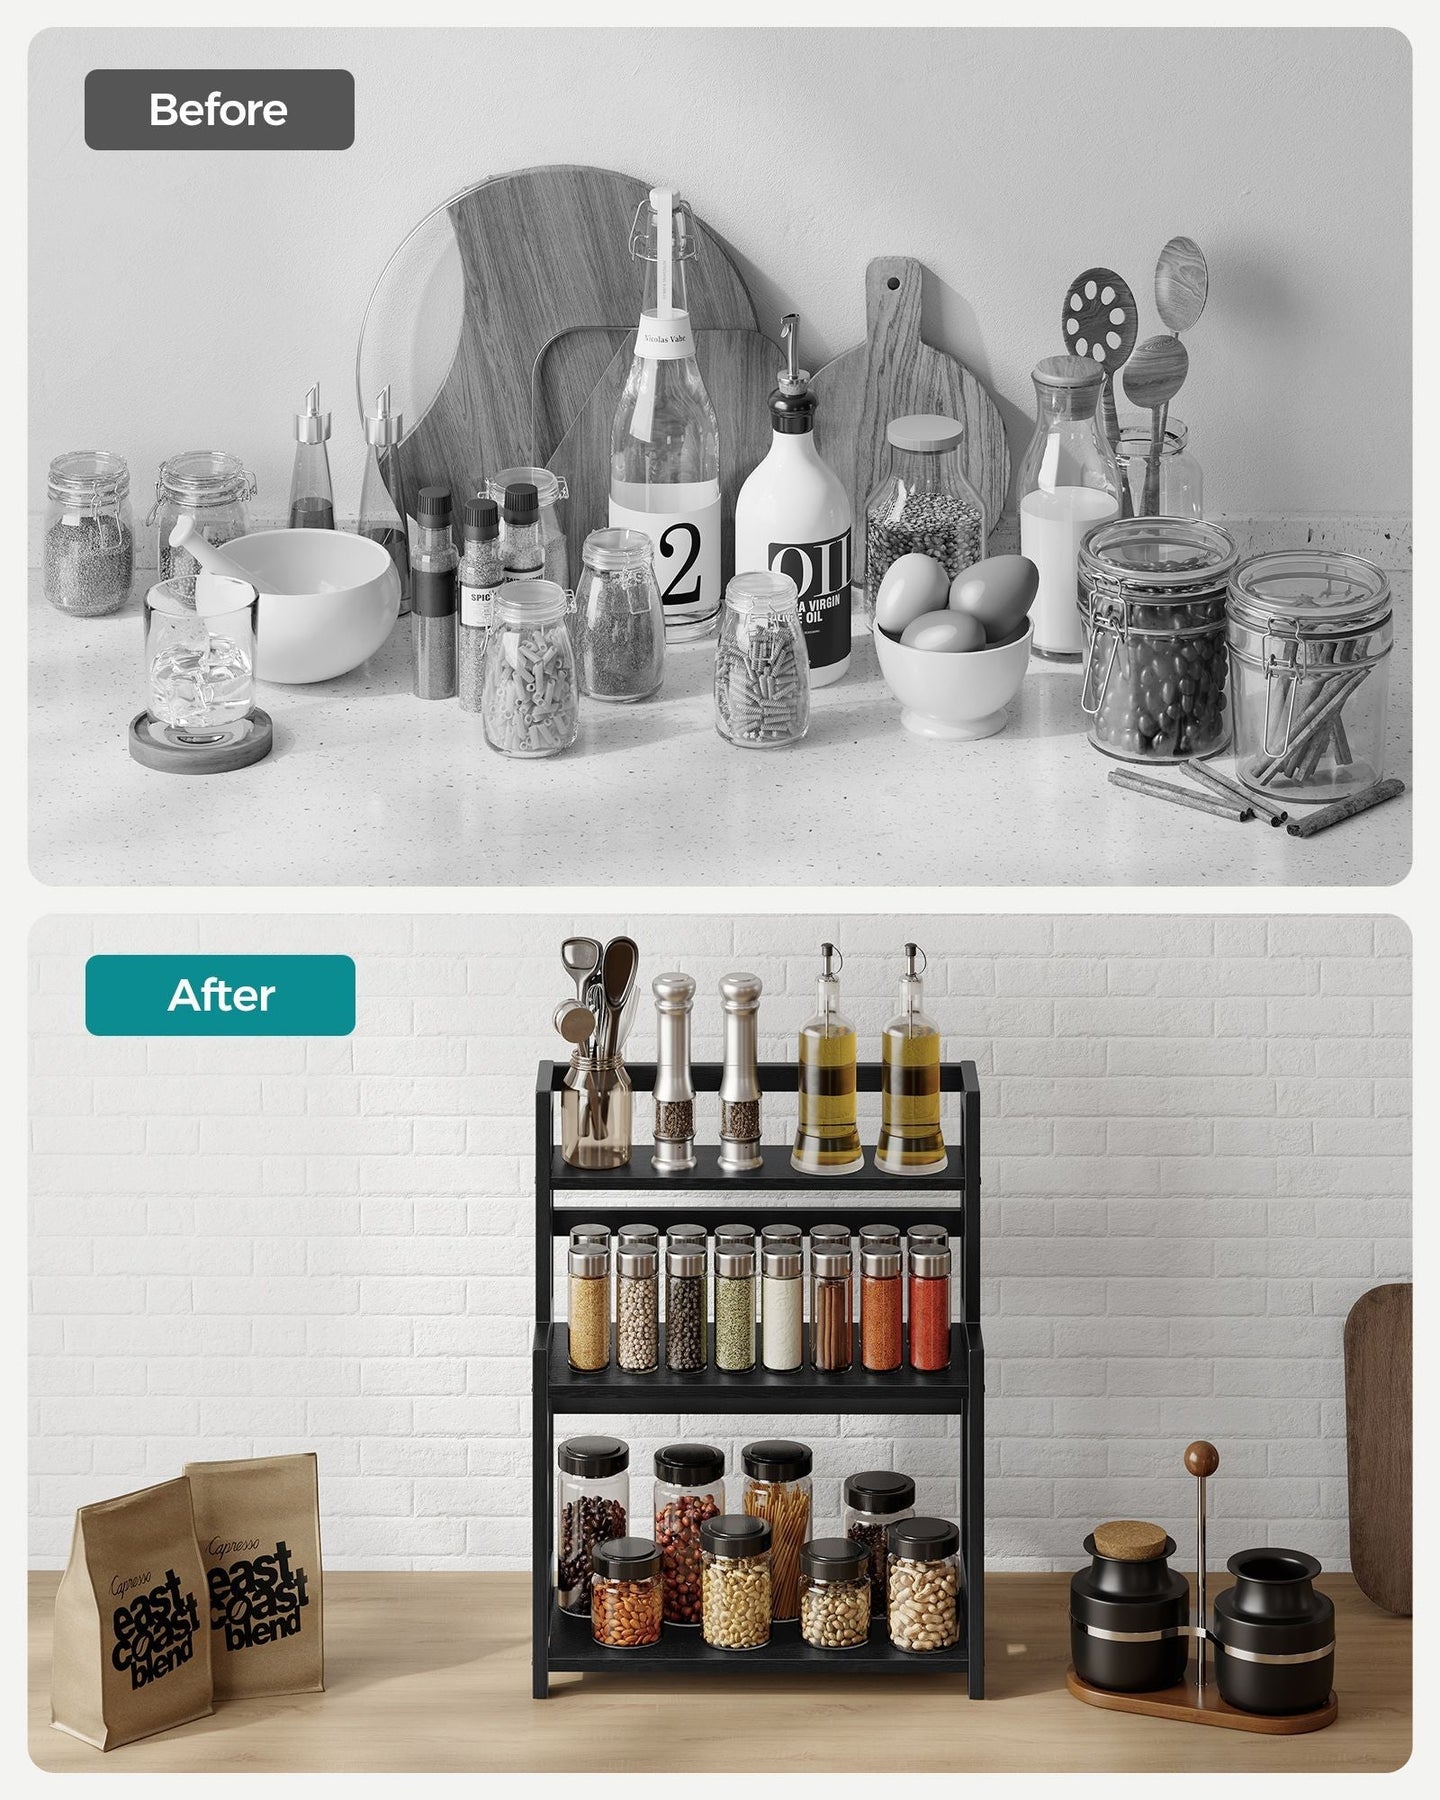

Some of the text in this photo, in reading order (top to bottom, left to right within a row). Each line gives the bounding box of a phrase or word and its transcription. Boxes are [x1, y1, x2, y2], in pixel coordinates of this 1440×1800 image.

[660, 523, 701, 605] 2
[471, 593, 492, 602] SPIC
[806, 610, 823, 624] OIL
[808, 593, 841, 612] VIRGIN
[207, 1541, 292, 1602] east
[211, 1567, 309, 1630] coast
[112, 1592, 201, 1672] coast
[113, 1568, 185, 1640] east
[225, 1604, 301, 1652] blend
[130, 1631, 194, 1690] blend
